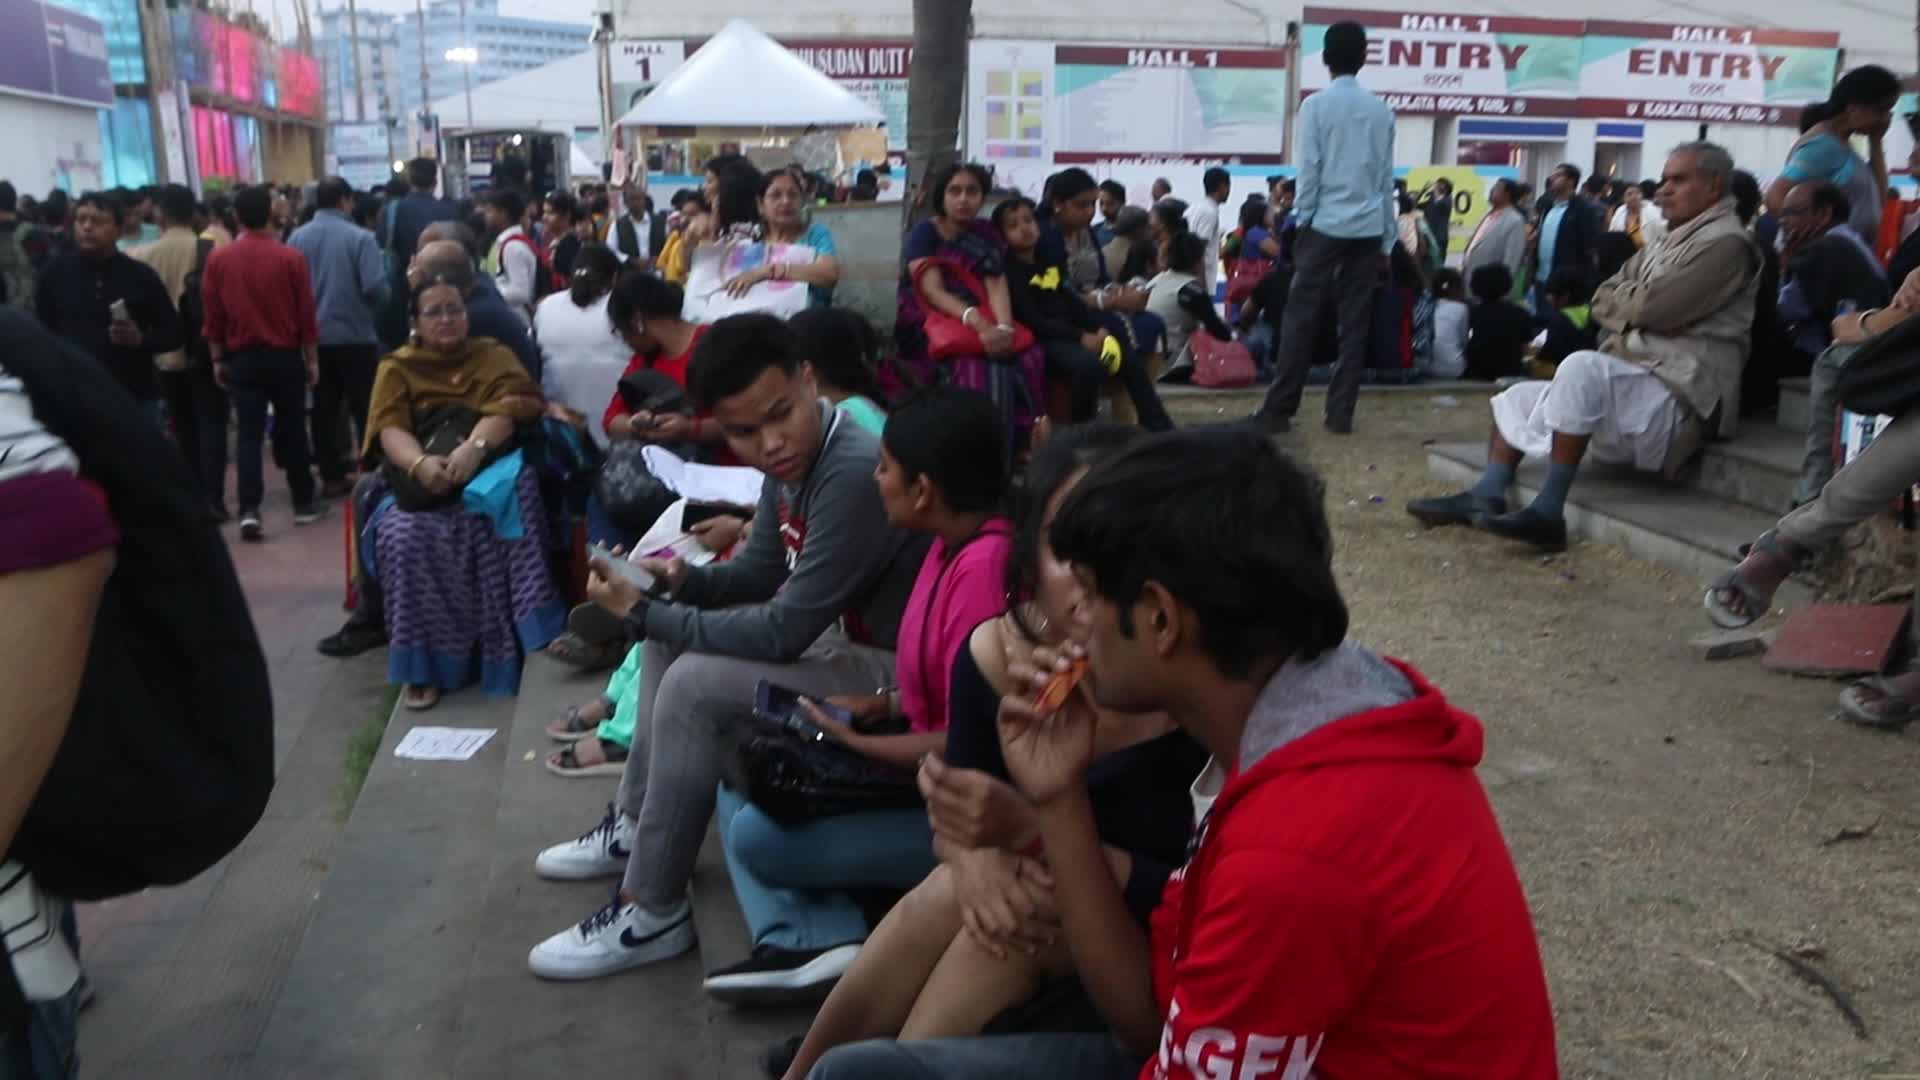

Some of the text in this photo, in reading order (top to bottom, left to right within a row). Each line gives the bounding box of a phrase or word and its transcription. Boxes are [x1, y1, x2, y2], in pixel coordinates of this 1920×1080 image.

[1400, 14, 1491, 34] HALL 1
[1671, 26, 1753, 44] HALL 1
[623, 45, 664, 56] HALL
[1127, 49, 1219, 67] HALL 1
[1365, 38, 1530, 71] ENTRY
[635, 57, 650, 81] 1
[1627, 48, 1787, 80] ENTRY
